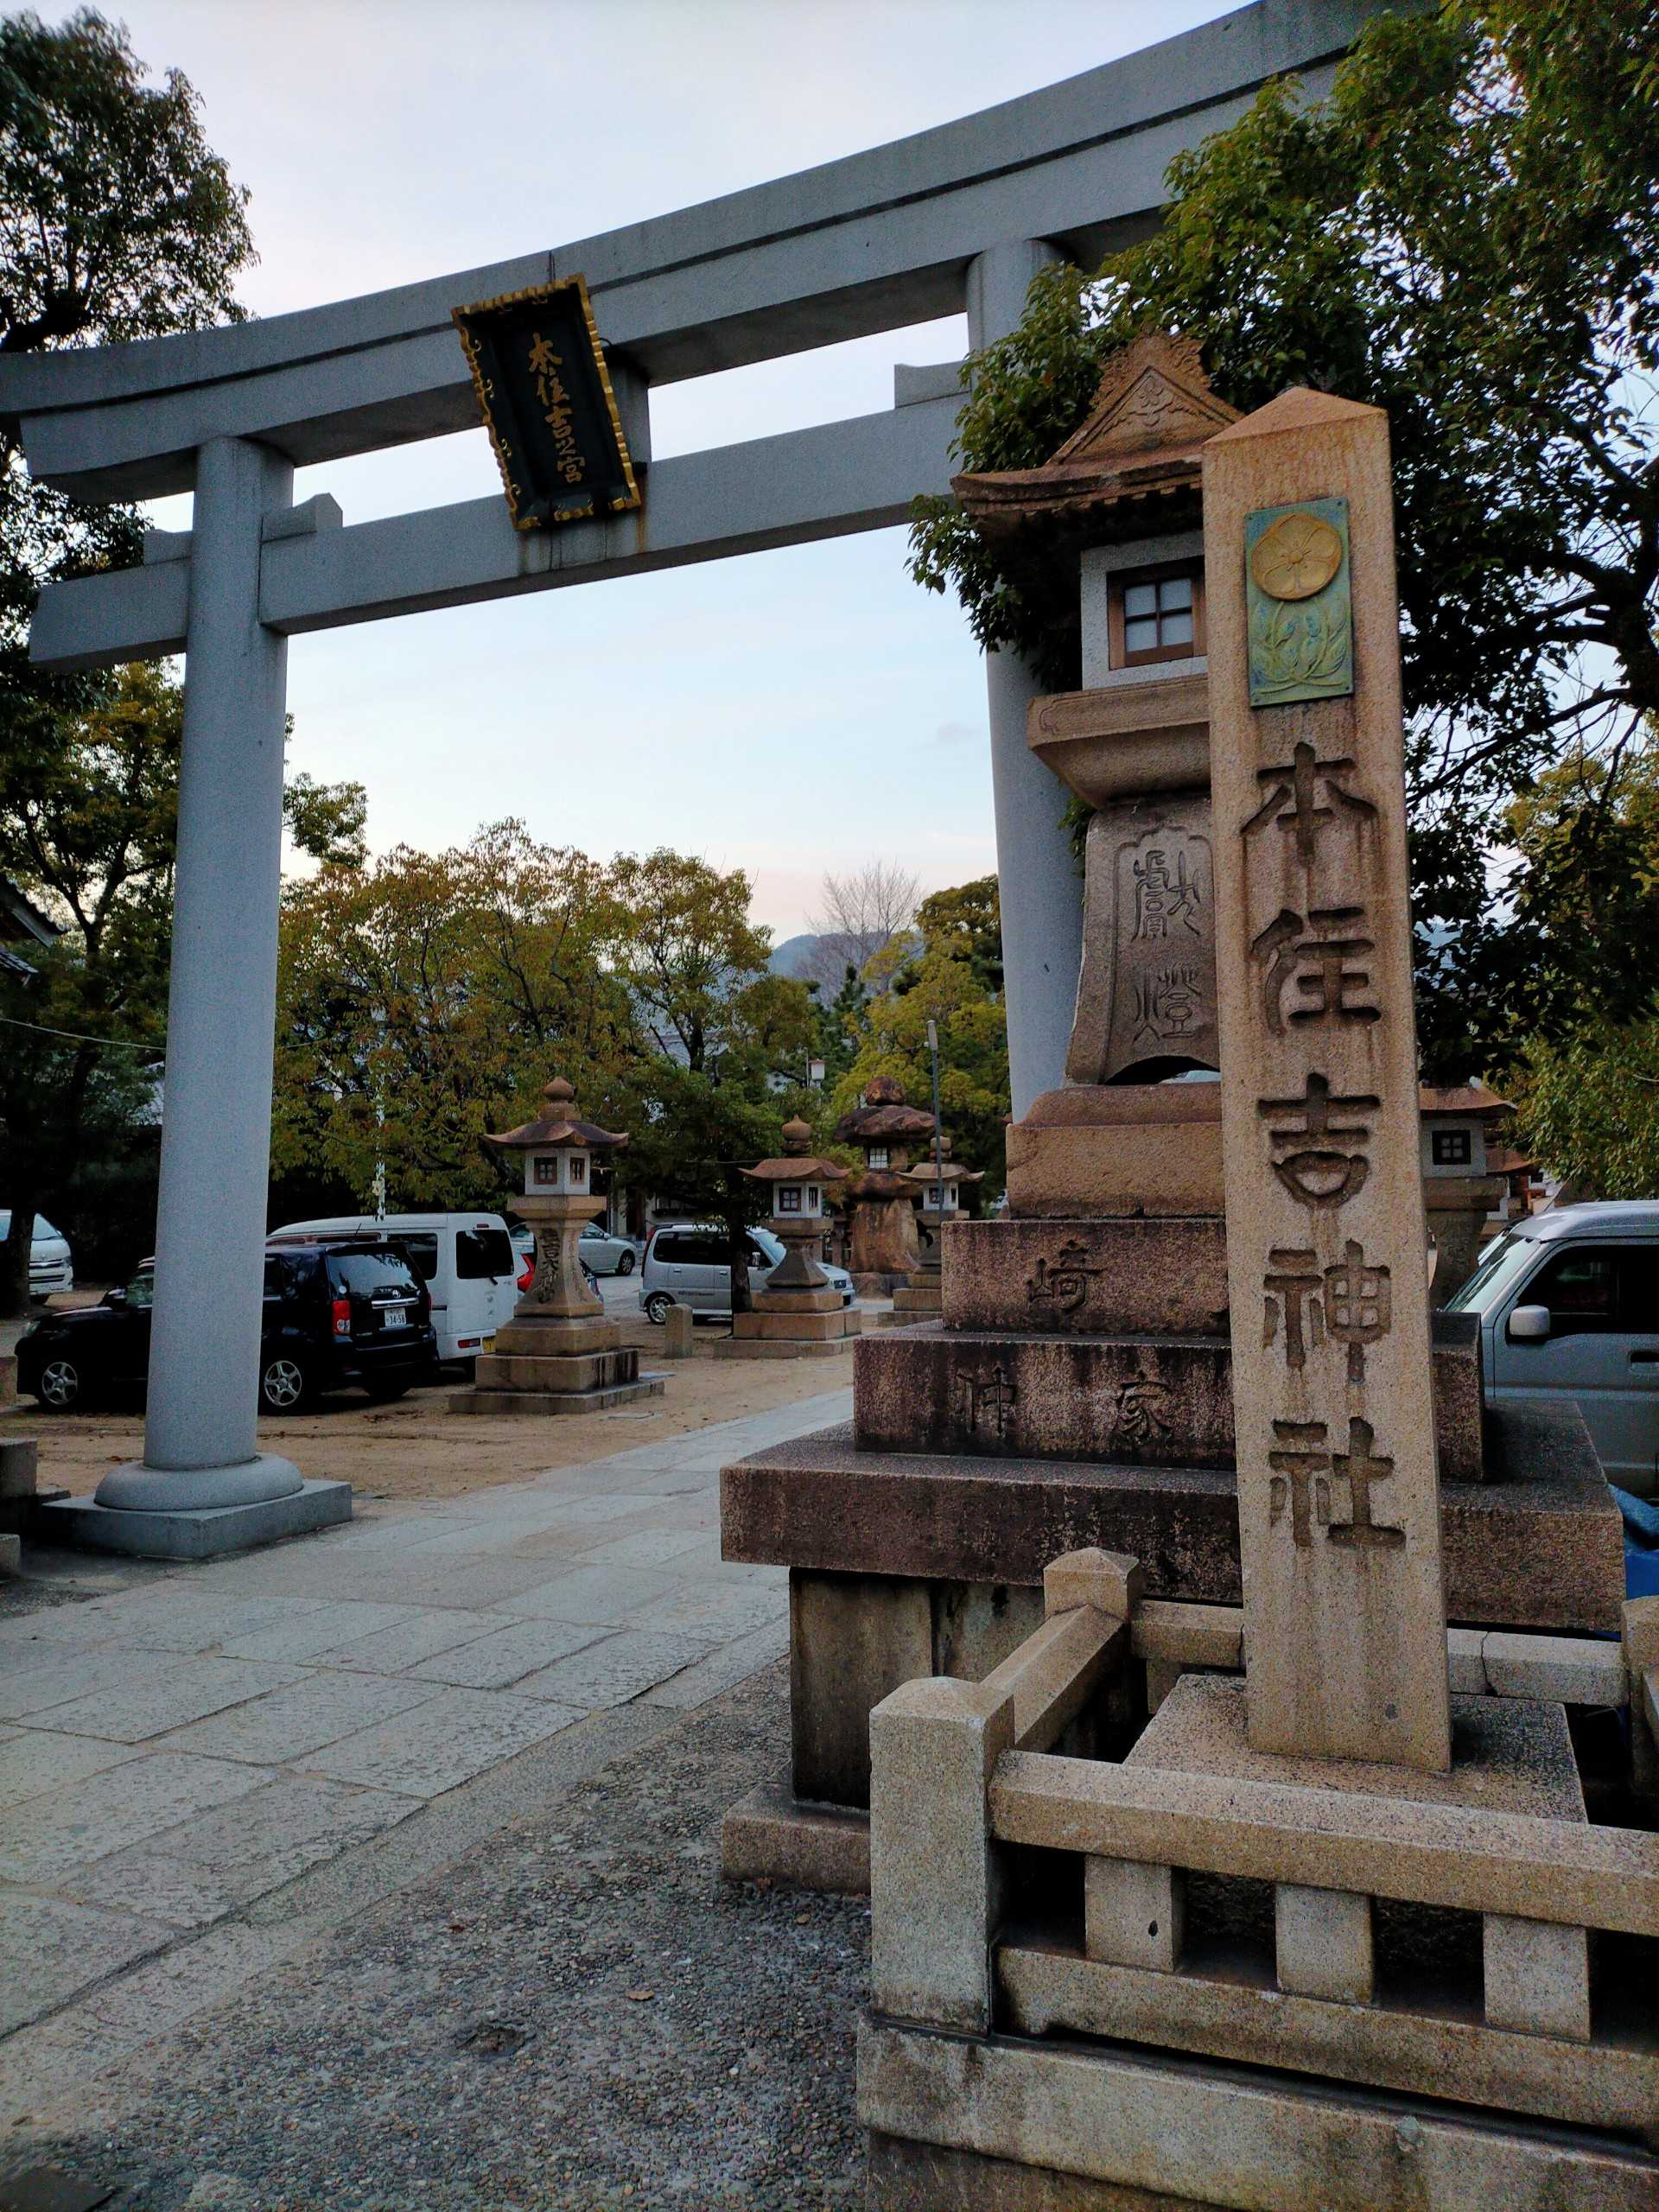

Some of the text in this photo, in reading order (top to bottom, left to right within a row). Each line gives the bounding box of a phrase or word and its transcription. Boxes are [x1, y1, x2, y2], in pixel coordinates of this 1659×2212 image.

[1241, 741, 1407, 1549] 本住吉神社
